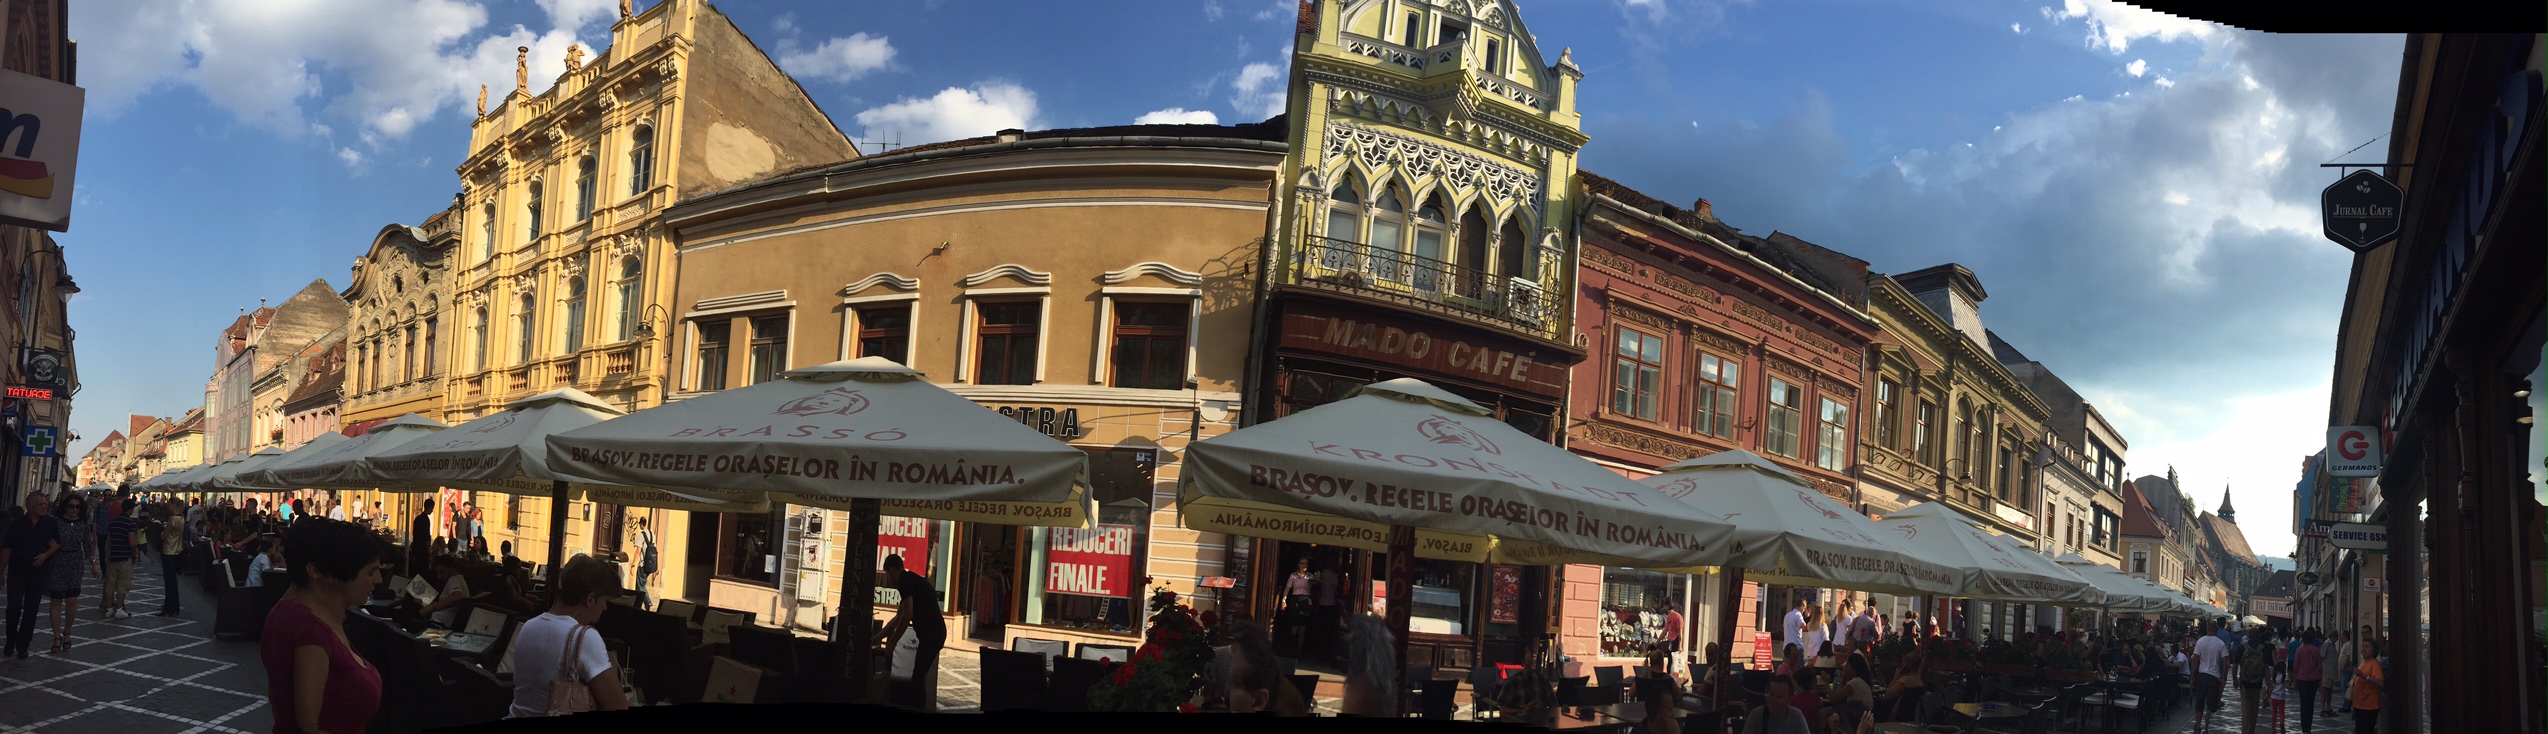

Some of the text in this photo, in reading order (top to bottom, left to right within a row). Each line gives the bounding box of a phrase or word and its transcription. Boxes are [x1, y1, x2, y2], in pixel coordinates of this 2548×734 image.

[2333, 204, 2393, 216] JURNAL CAFE
[1322, 317, 1536, 383] MADO CAFÉ
[6, 387, 52, 399] TATUAJE
[669, 424, 907, 442] BRASSÓ
[636, 453, 708, 472] REGELE
[850, 455, 878, 481] ÎN
[887, 458, 1025, 486] ROMÂNIA.
[1364, 482, 1453, 513] REGELE
[1576, 511, 1600, 538] ÎN
[1606, 522, 1705, 551] ROMÂNIA.
[1051, 527, 1132, 556] REDUCERI
[2333, 531, 2367, 541] SERVICE
[1049, 562, 1111, 595] FINALE.
